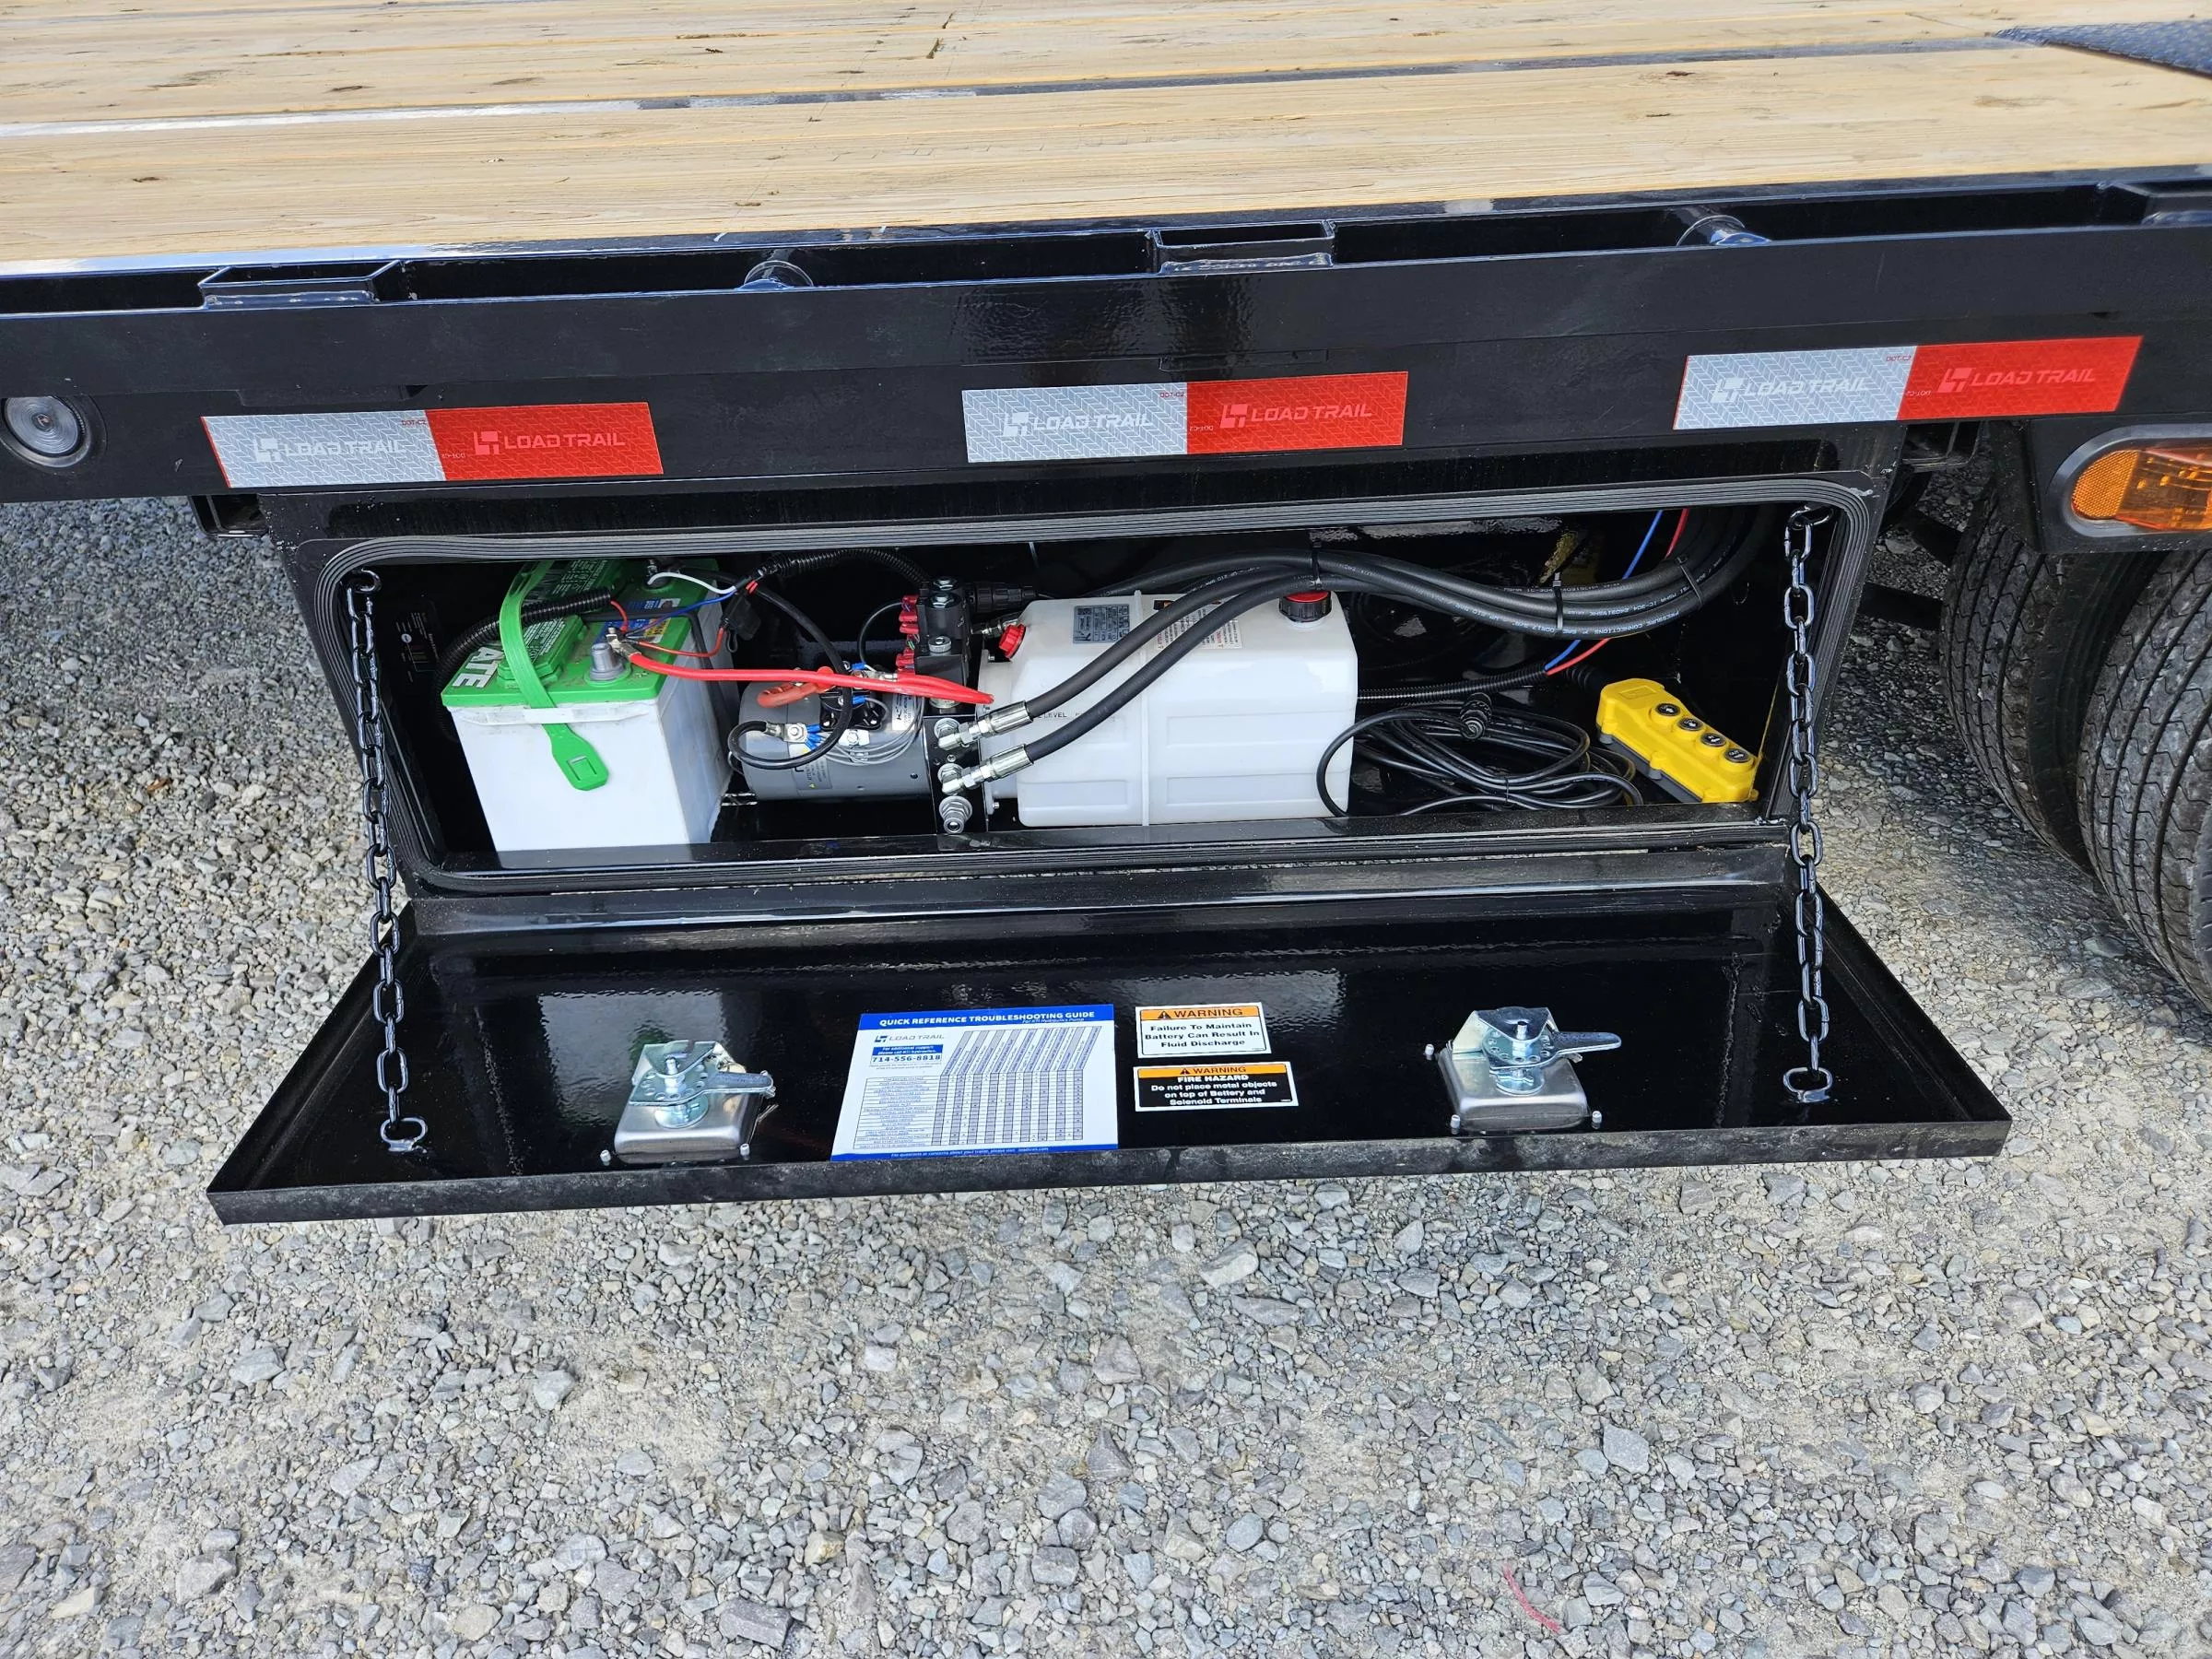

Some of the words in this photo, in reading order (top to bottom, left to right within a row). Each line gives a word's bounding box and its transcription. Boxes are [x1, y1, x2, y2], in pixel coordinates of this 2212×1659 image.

[1970, 371, 2034, 387] LOAD
[2036, 369, 2096, 384] TRAIL
[1744, 382, 1806, 395] LOAD
[1808, 378, 1869, 393] TRAIL
[1251, 406, 1309, 422] LOAD
[1312, 404, 1372, 419] TRAIL
[1034, 415, 1090, 430] LOAD
[1094, 414, 1153, 429] TRAIL
[286, 442, 342, 456] LOAD
[344, 440, 406, 454] TRAIL
[504, 434, 561, 450] LOAD
[563, 432, 626, 447] TRAIL
[879, 1018, 911, 1027] QUICK
[912, 1016, 967, 1025] REFERENCE
[969, 1012, 1064, 1023] TROUBLESHOOTING
[1173, 1007, 1243, 1018] WARNING
[872, 1054, 942, 1063] 714-556-8818
[1193, 1066, 1247, 1075] WARNING
[1185, 1083, 1211, 1091] place
[1241, 1080, 1277, 1088] objects
[1179, 1091, 1196, 1100] top
[1210, 1089, 1245, 1098] Battery
